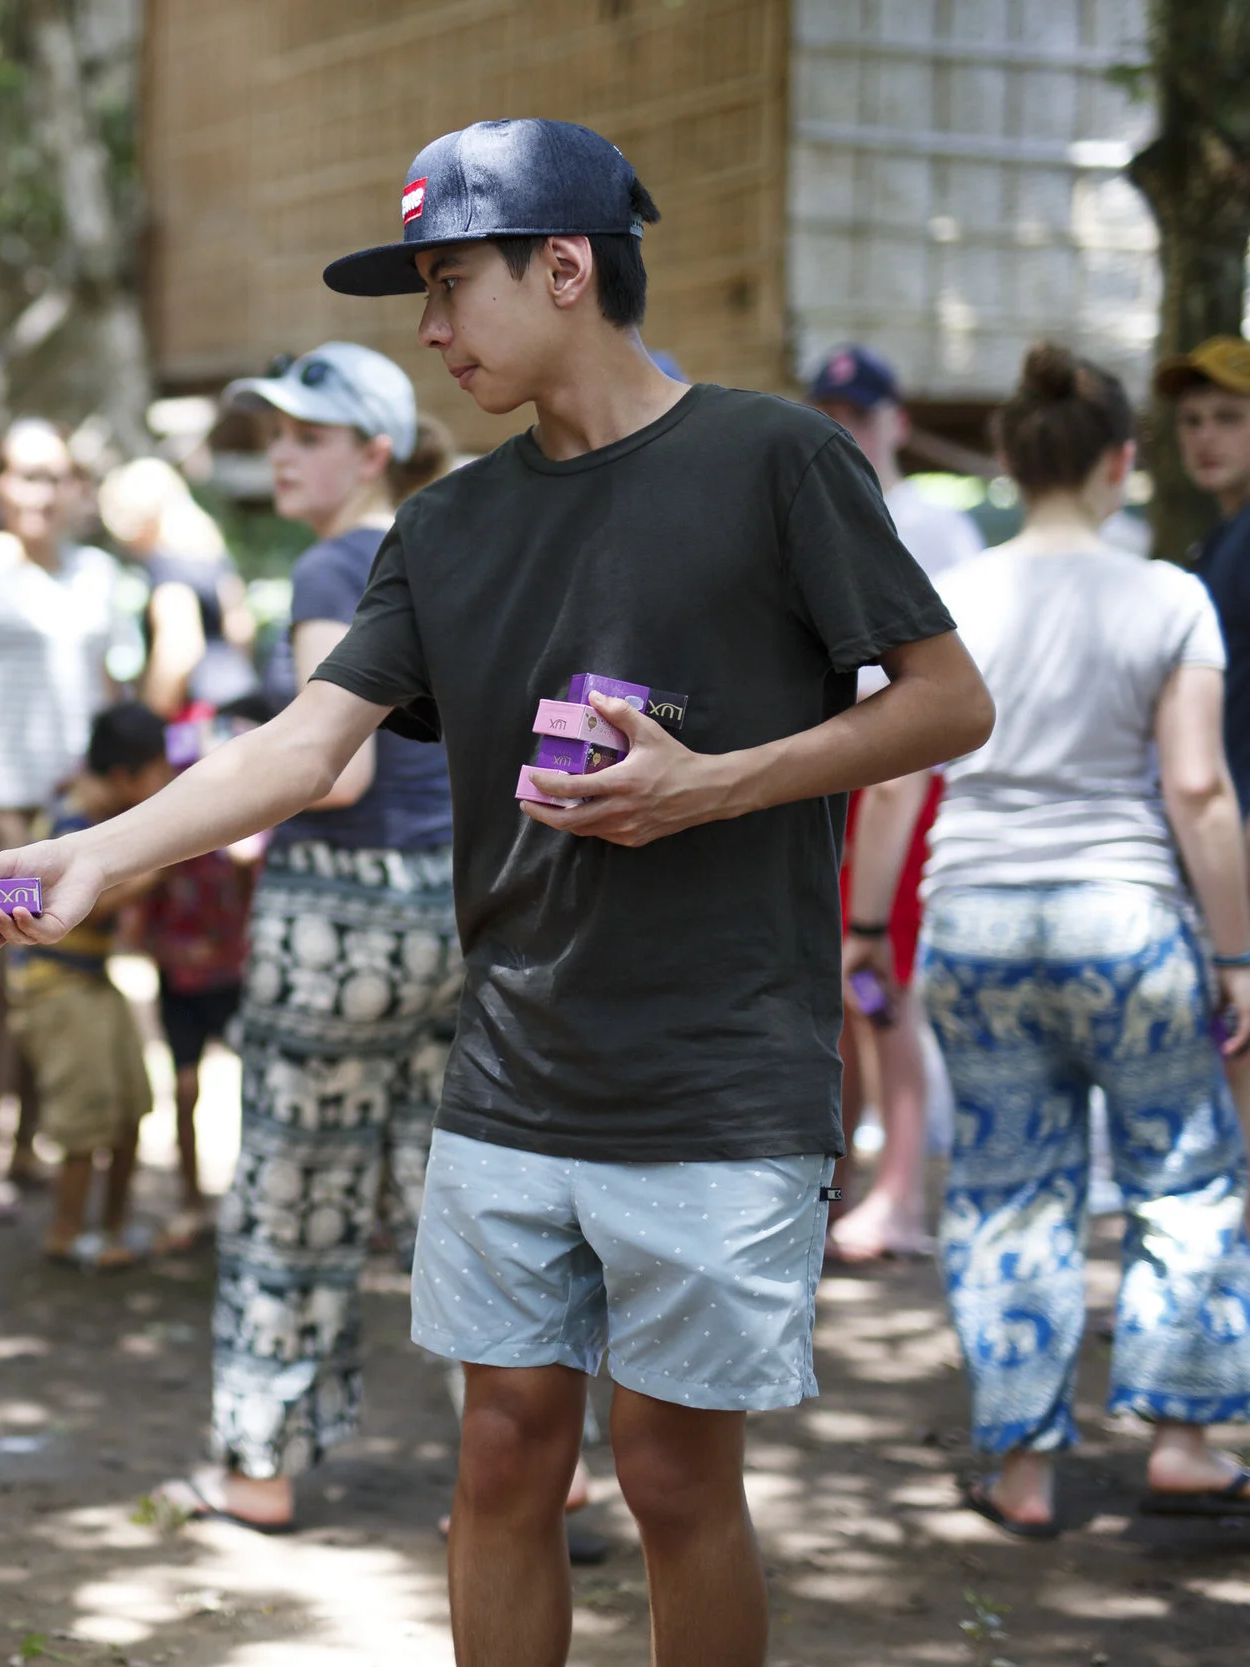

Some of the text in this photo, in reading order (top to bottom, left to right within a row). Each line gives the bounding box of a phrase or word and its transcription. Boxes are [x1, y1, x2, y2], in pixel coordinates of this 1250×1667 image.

[648, 699, 683, 721] LUX
[549, 718, 567, 730] LUX
[553, 754, 572, 767] LUX
[0, 887, 38, 904] LUX
